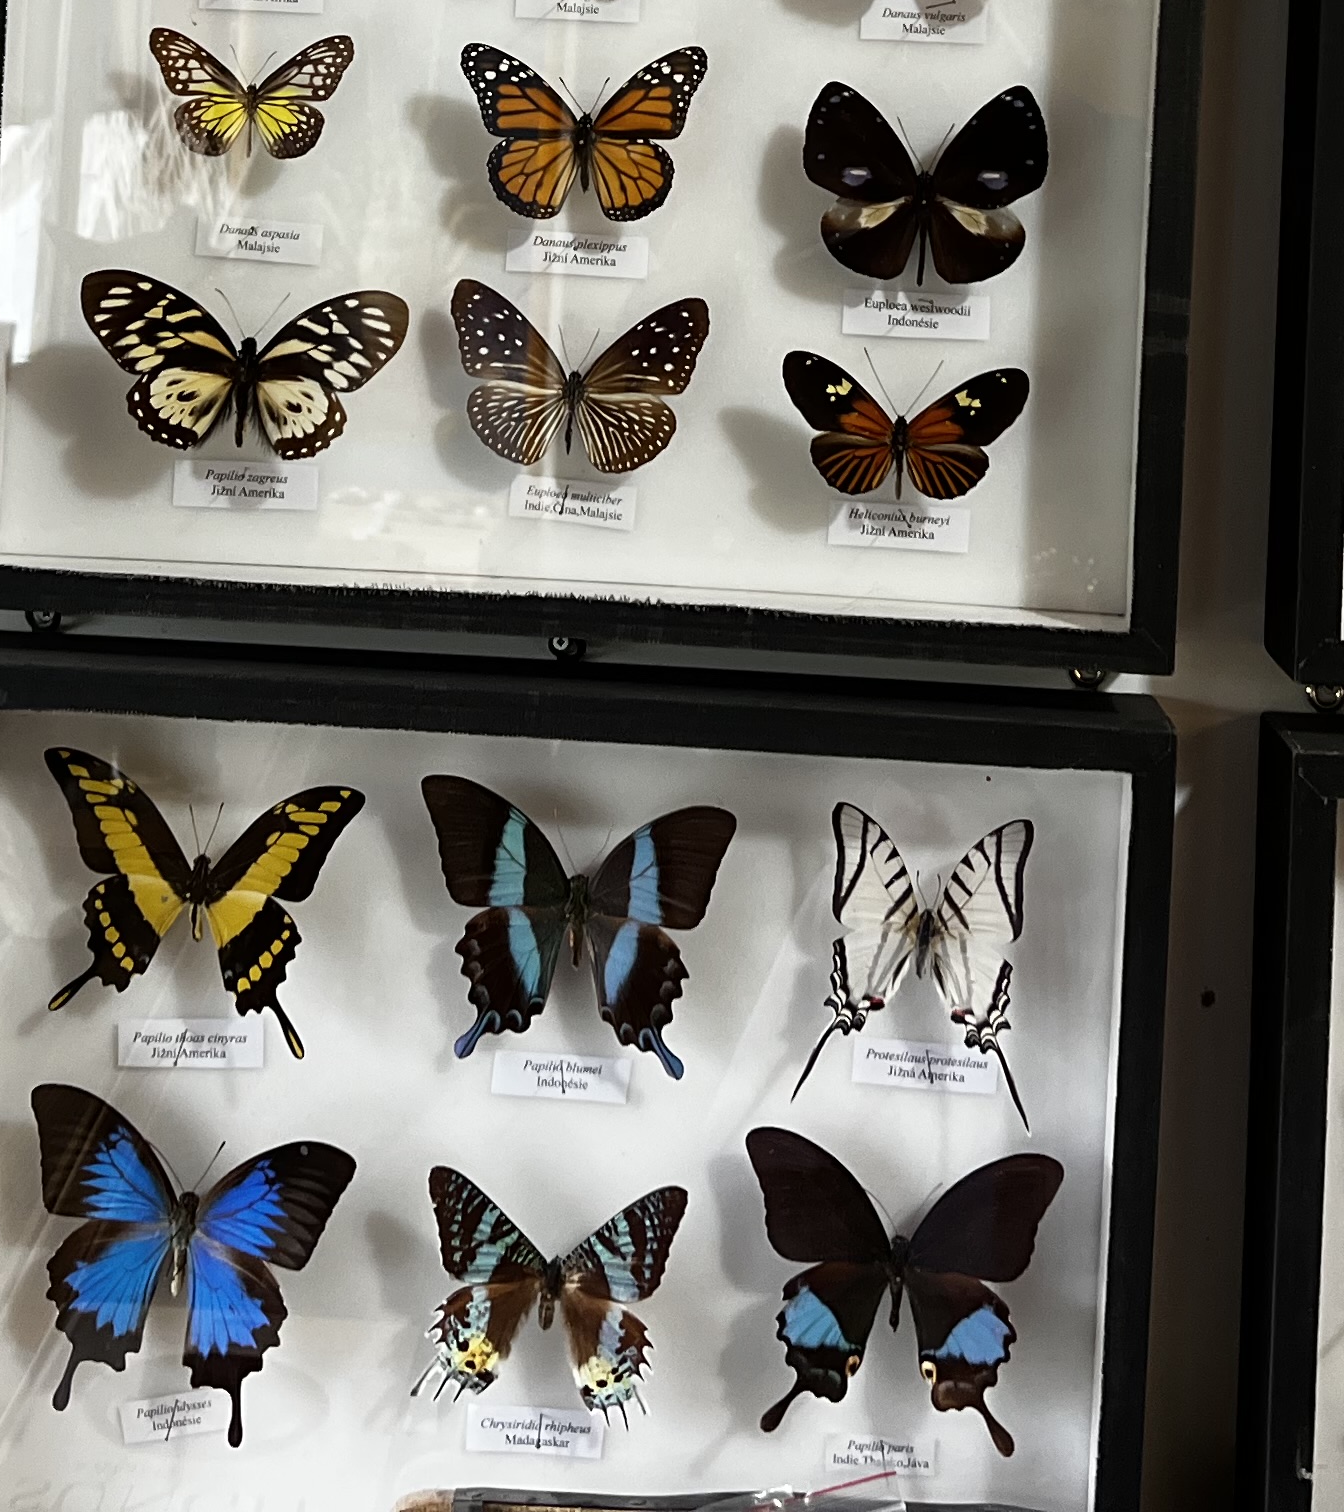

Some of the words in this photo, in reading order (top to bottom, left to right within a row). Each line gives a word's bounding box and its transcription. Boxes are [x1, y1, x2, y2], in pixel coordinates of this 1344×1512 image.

[556, 2, 600, 16] Malajsie
[881, 8, 921, 20] Danaus
[924, 9, 966, 23] vulgaris
[901, 23, 946, 37] Malajsie
[237, 239, 281, 254] Malajsie
[533, 235, 574, 249] Danaus
[576, 238, 627, 256] plexippus
[542, 251, 567, 264] Jižní
[570, 253, 616, 267] Amerika
[864, 297, 907, 312] Euploea
[887, 314, 939, 329] Indonésie
[205, 470, 245, 484] Papilio
[246, 474, 289, 486] zagreus
[211, 485, 238, 498] Jižní
[240, 487, 286, 500] Amerika
[848, 508, 906, 524] Heliconius
[908, 512, 951, 528] burneyi
[860, 523, 885, 536] Jižní
[887, 526, 935, 540] Amerika
[133, 1032, 173, 1045] Papilio
[151, 1048, 179, 1060] Jižní
[180, 1048, 227, 1060] Amerika
[866, 1048, 927, 1064] Protesilaus
[565, 1062, 602, 1075] blumei
[917, 1068, 965, 1083] Amerika
[544, 1423, 592, 1437] rhipheus
[886, 1444, 914, 1455] paris
